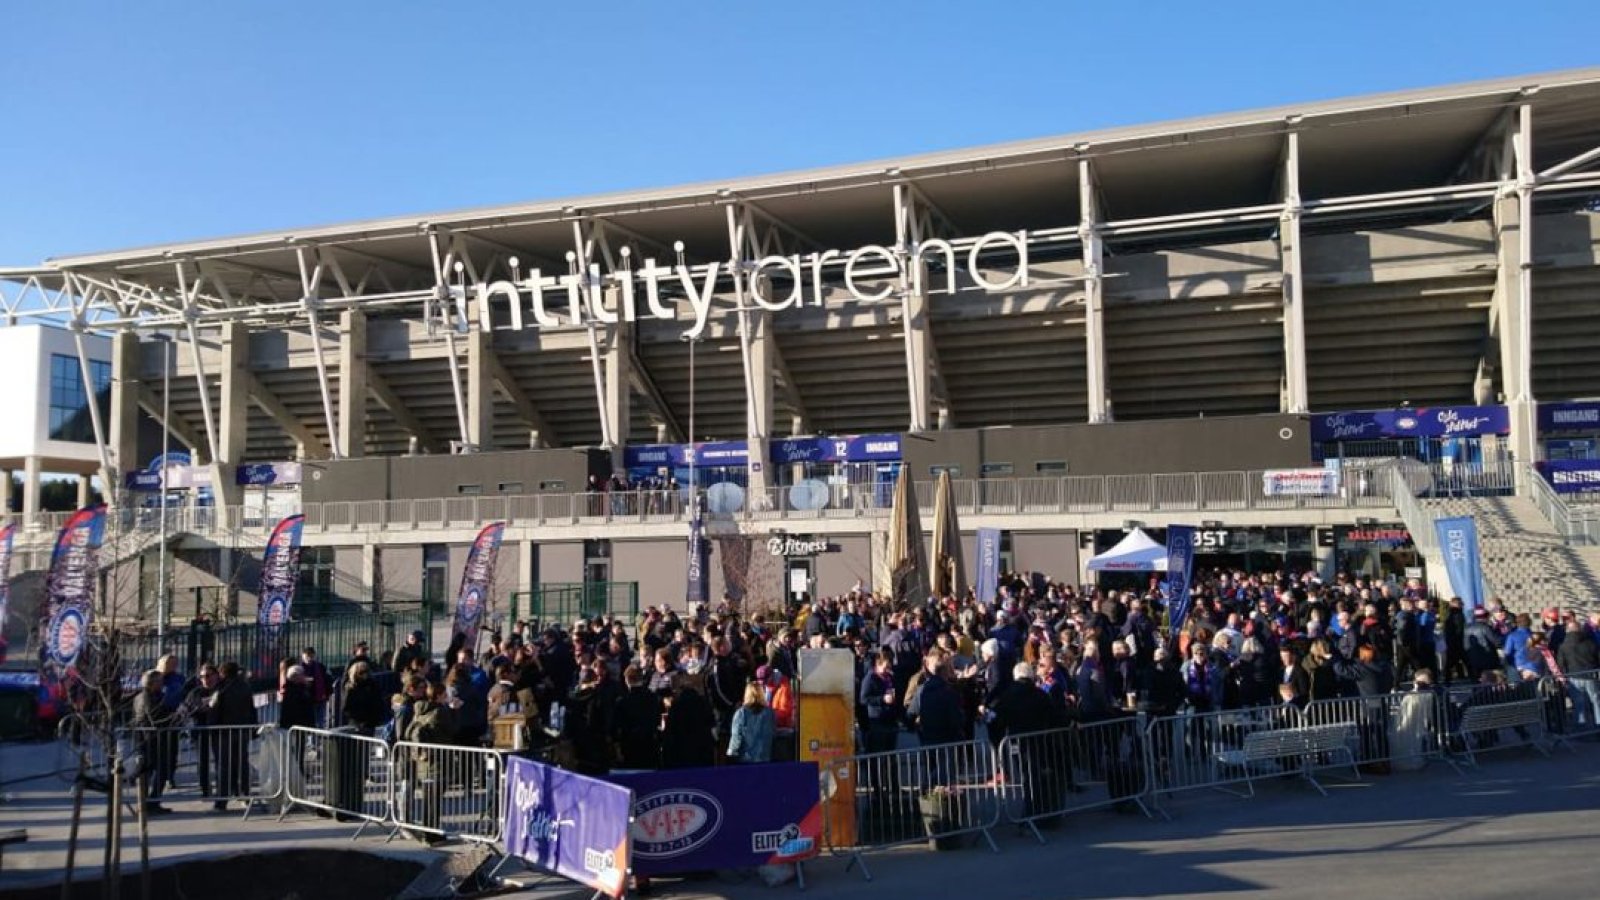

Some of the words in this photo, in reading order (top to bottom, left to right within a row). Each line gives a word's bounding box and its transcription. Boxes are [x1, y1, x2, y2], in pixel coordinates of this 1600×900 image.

[449, 241, 721, 341] intility
[750, 229, 1028, 312] arena
[1552, 409, 1599, 423] INNGANG
[835, 440, 848, 457] 12
[784, 536, 828, 556] fitness
[983, 538, 993, 568] BAR
[755, 833, 783, 850] ELITE
